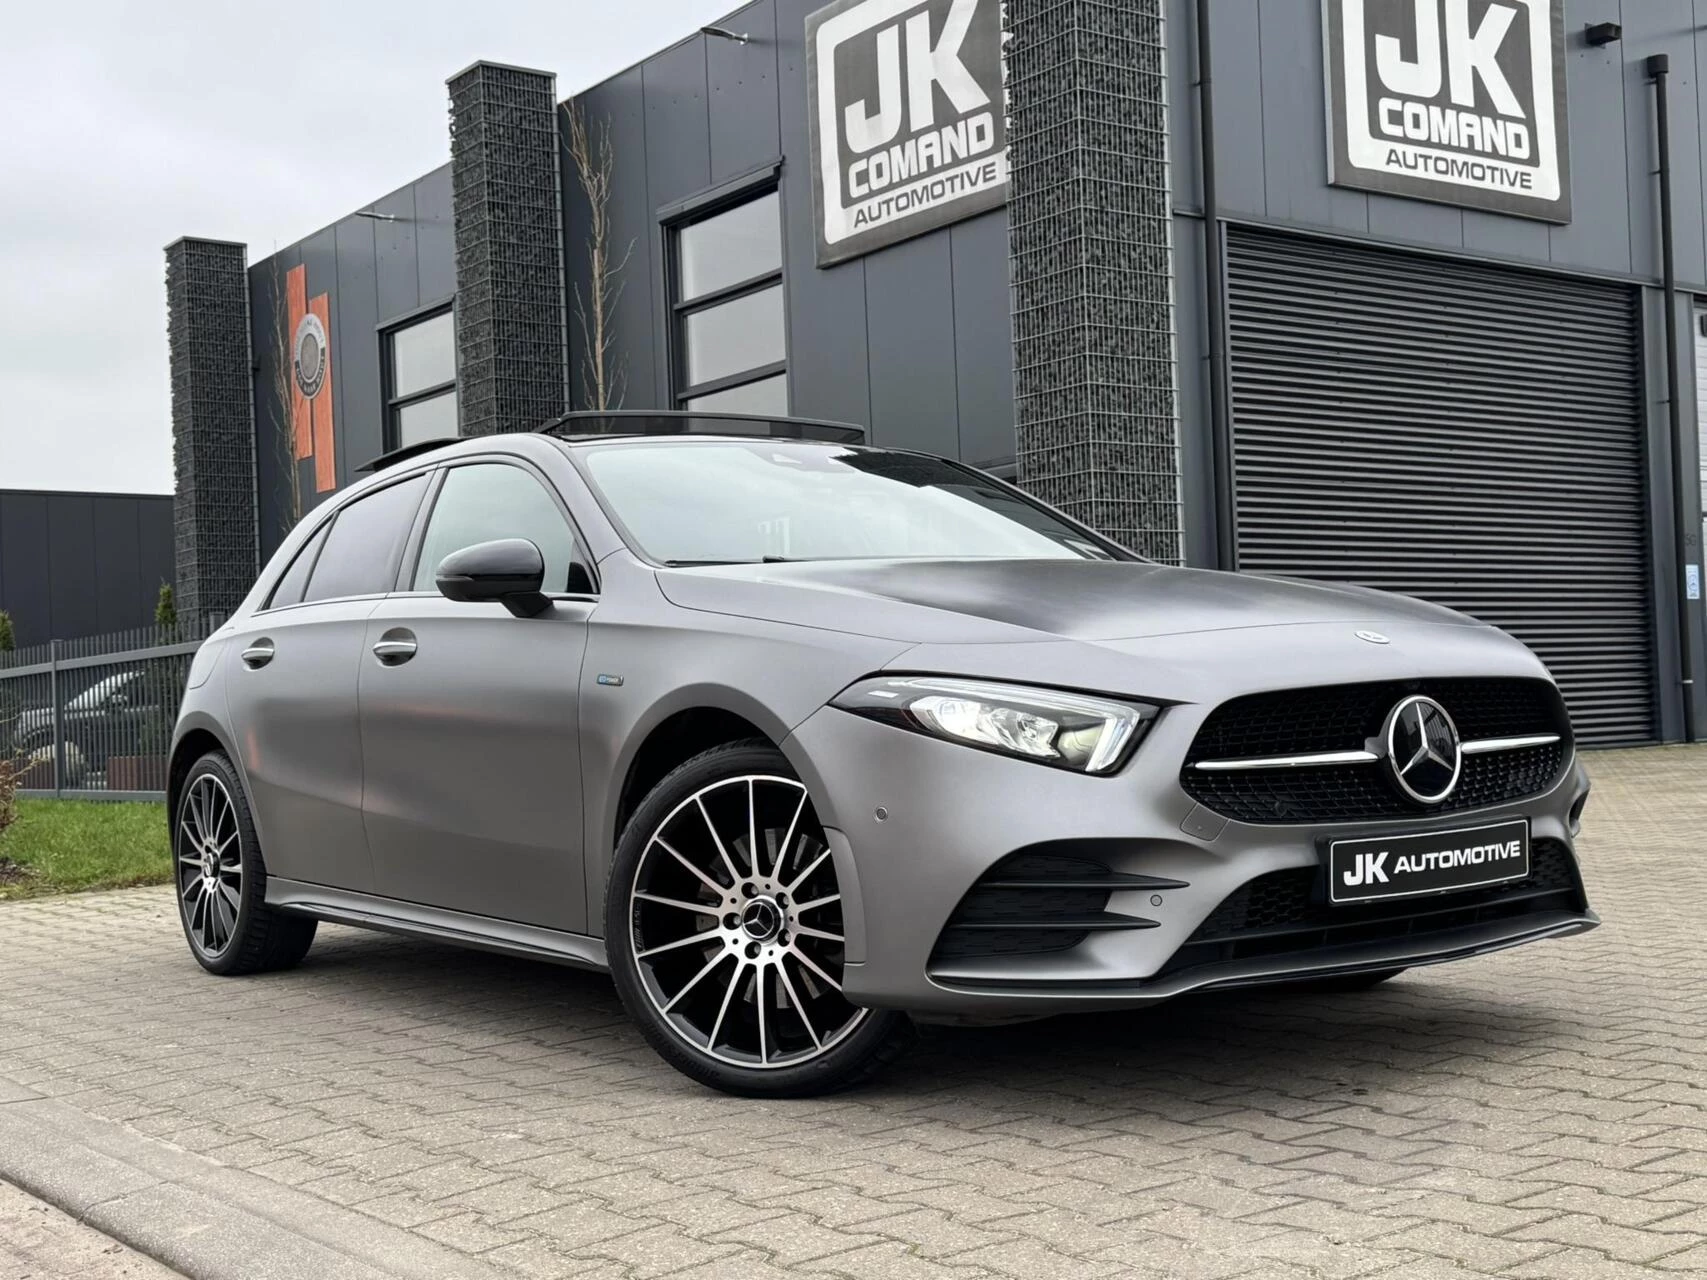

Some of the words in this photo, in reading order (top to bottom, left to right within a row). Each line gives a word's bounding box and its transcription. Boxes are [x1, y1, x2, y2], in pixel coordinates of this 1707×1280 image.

[844, 0, 991, 153] JK
[1375, 0, 1526, 119] JK
[849, 112, 994, 198] COMAND
[1379, 97, 1530, 160] COMAND
[854, 161, 996, 228] AUTOMOTIVE
[1386, 148, 1532, 190] AUTOMOTIVE
[1343, 852, 1389, 886] JK
[1394, 840, 1520, 874] AUTOMOTIVE
